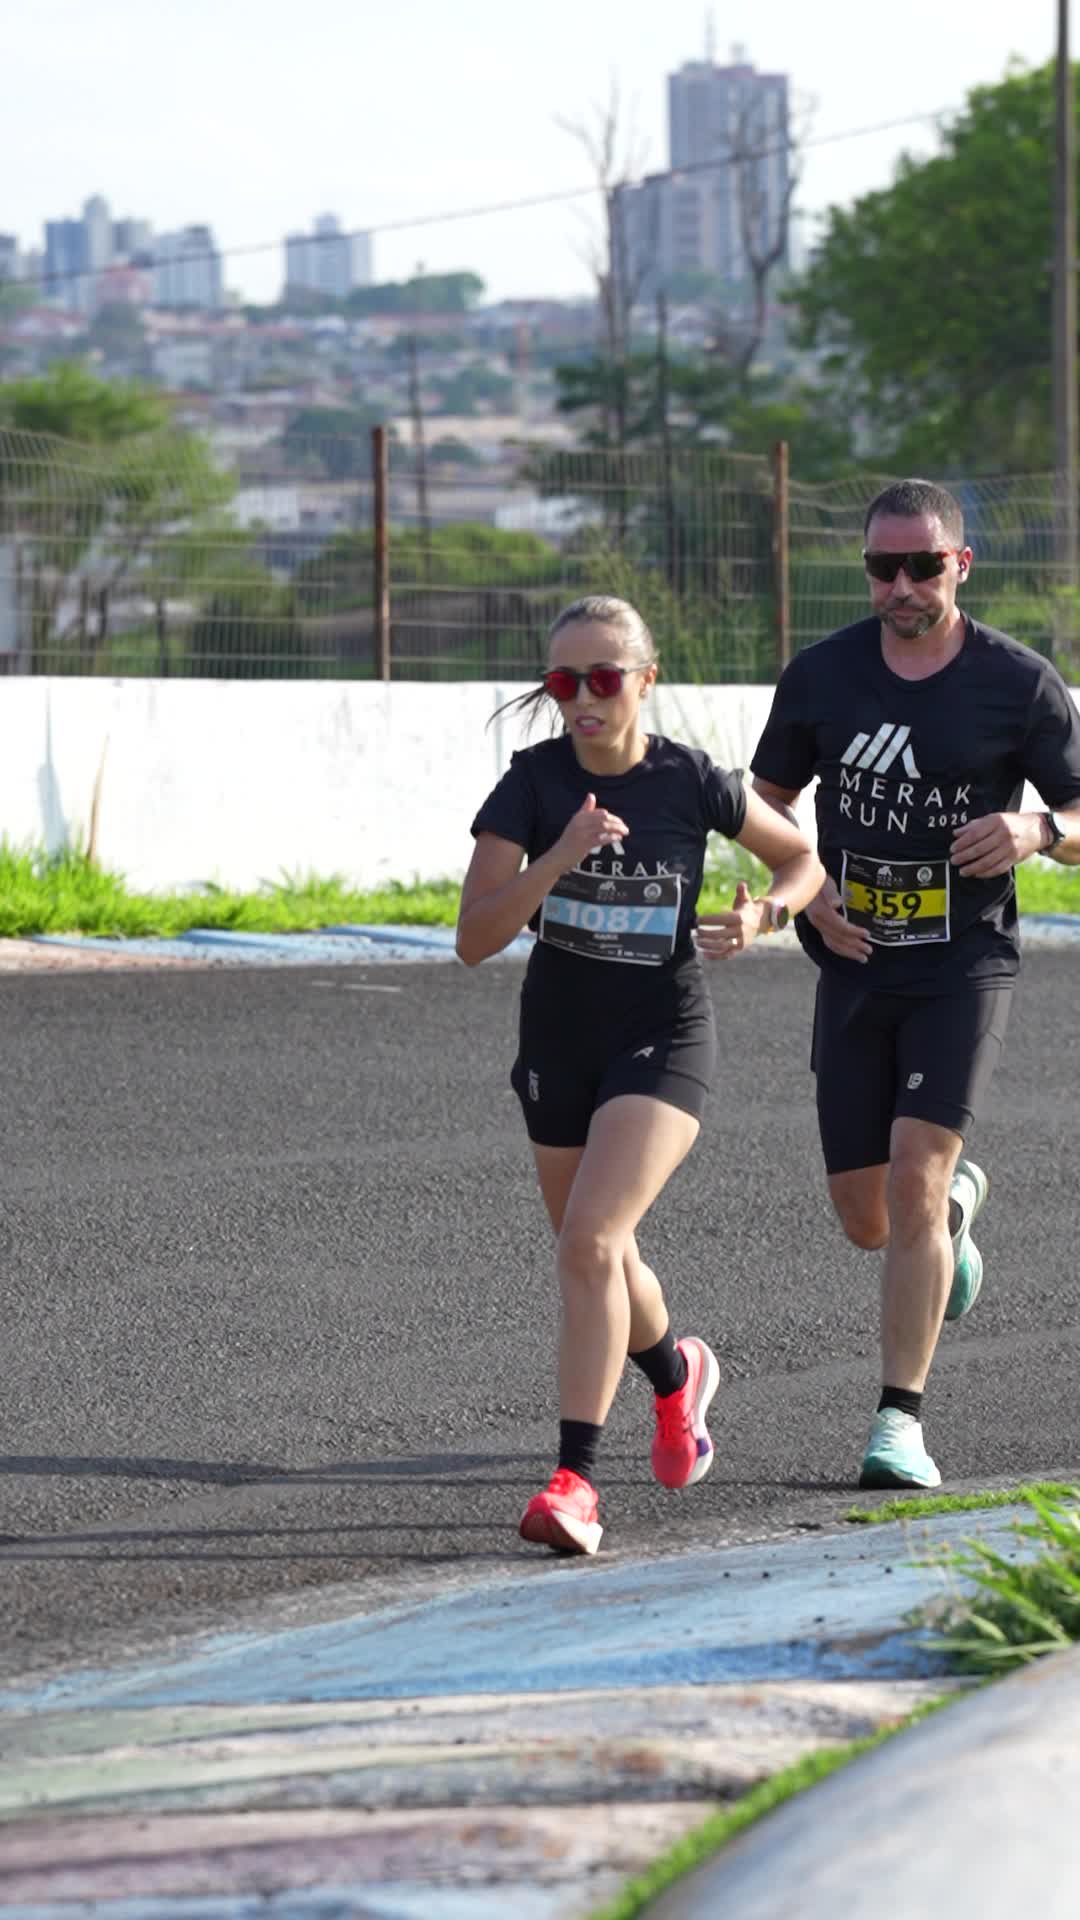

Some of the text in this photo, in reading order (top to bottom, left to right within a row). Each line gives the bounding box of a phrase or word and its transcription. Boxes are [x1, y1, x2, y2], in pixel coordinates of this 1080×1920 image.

[839, 767, 971, 808] MERAK
[839, 793, 968, 834] RUN 2026
[564, 901, 656, 933] 1087
[864, 887, 922, 919] 359
